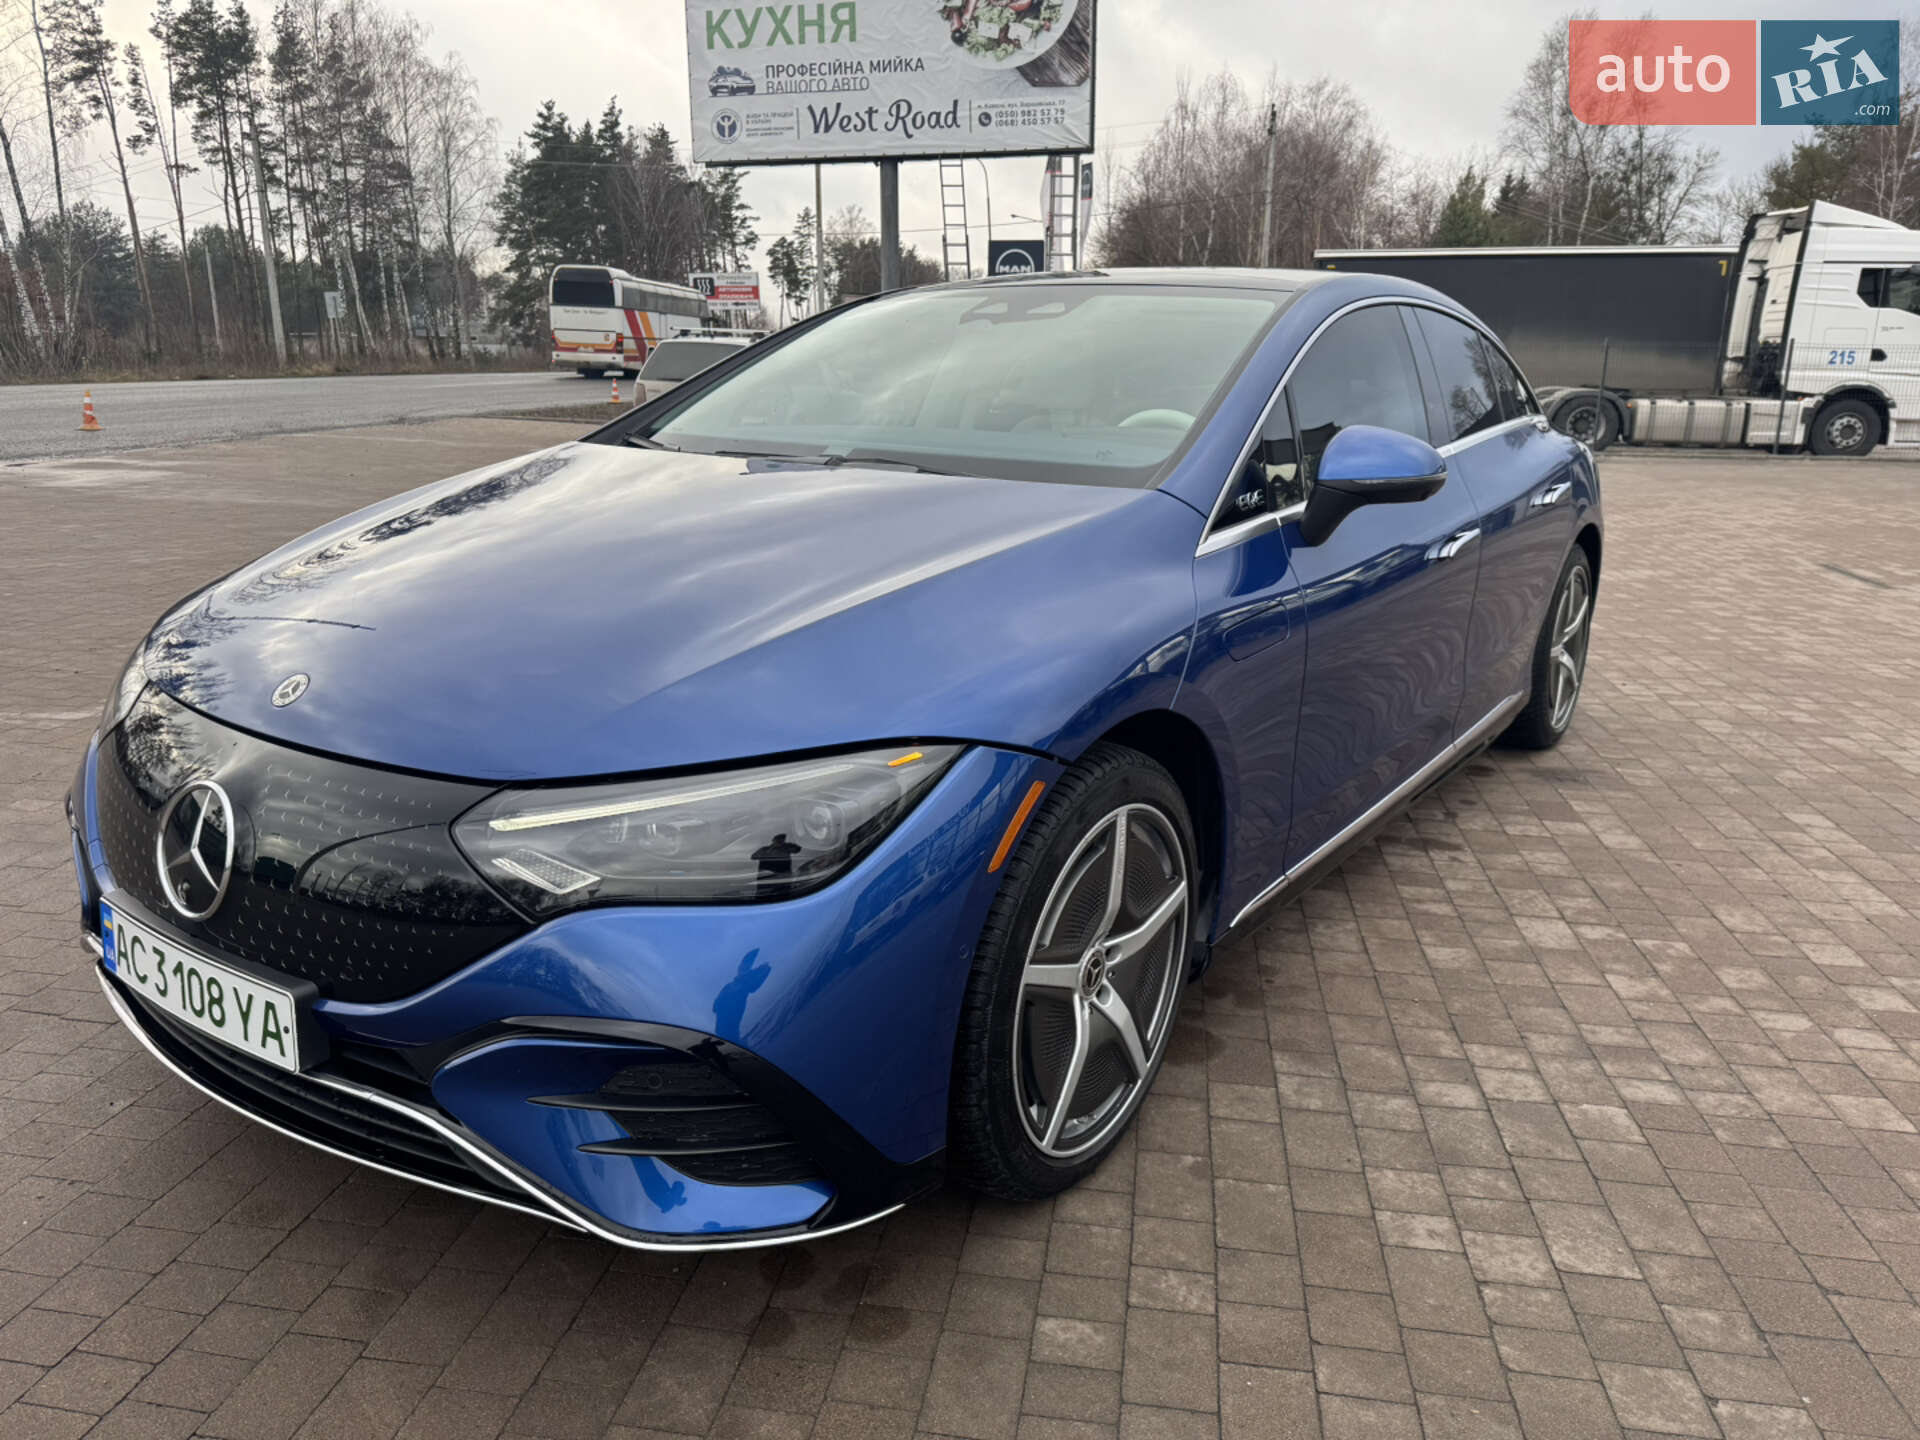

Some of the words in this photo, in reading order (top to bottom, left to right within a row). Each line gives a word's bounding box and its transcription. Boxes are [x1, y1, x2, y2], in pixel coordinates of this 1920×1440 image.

[706, 1, 857, 50] КУХНЯ
[765, 58, 865, 79] ПРОФЕСІЙНА
[869, 55, 925, 74] МИЙКА
[766, 78, 828, 94] ВАШОГО
[832, 76, 870, 92] АВТО
[807, 102, 879, 134] West
[884, 98, 961, 139] Road
[999, 264, 1032, 273] MAN
[1828, 350, 1856, 366] 215
[117, 923, 149, 985] AC
[152, 945, 226, 1028] 3108
[233, 986, 287, 1058] YA
